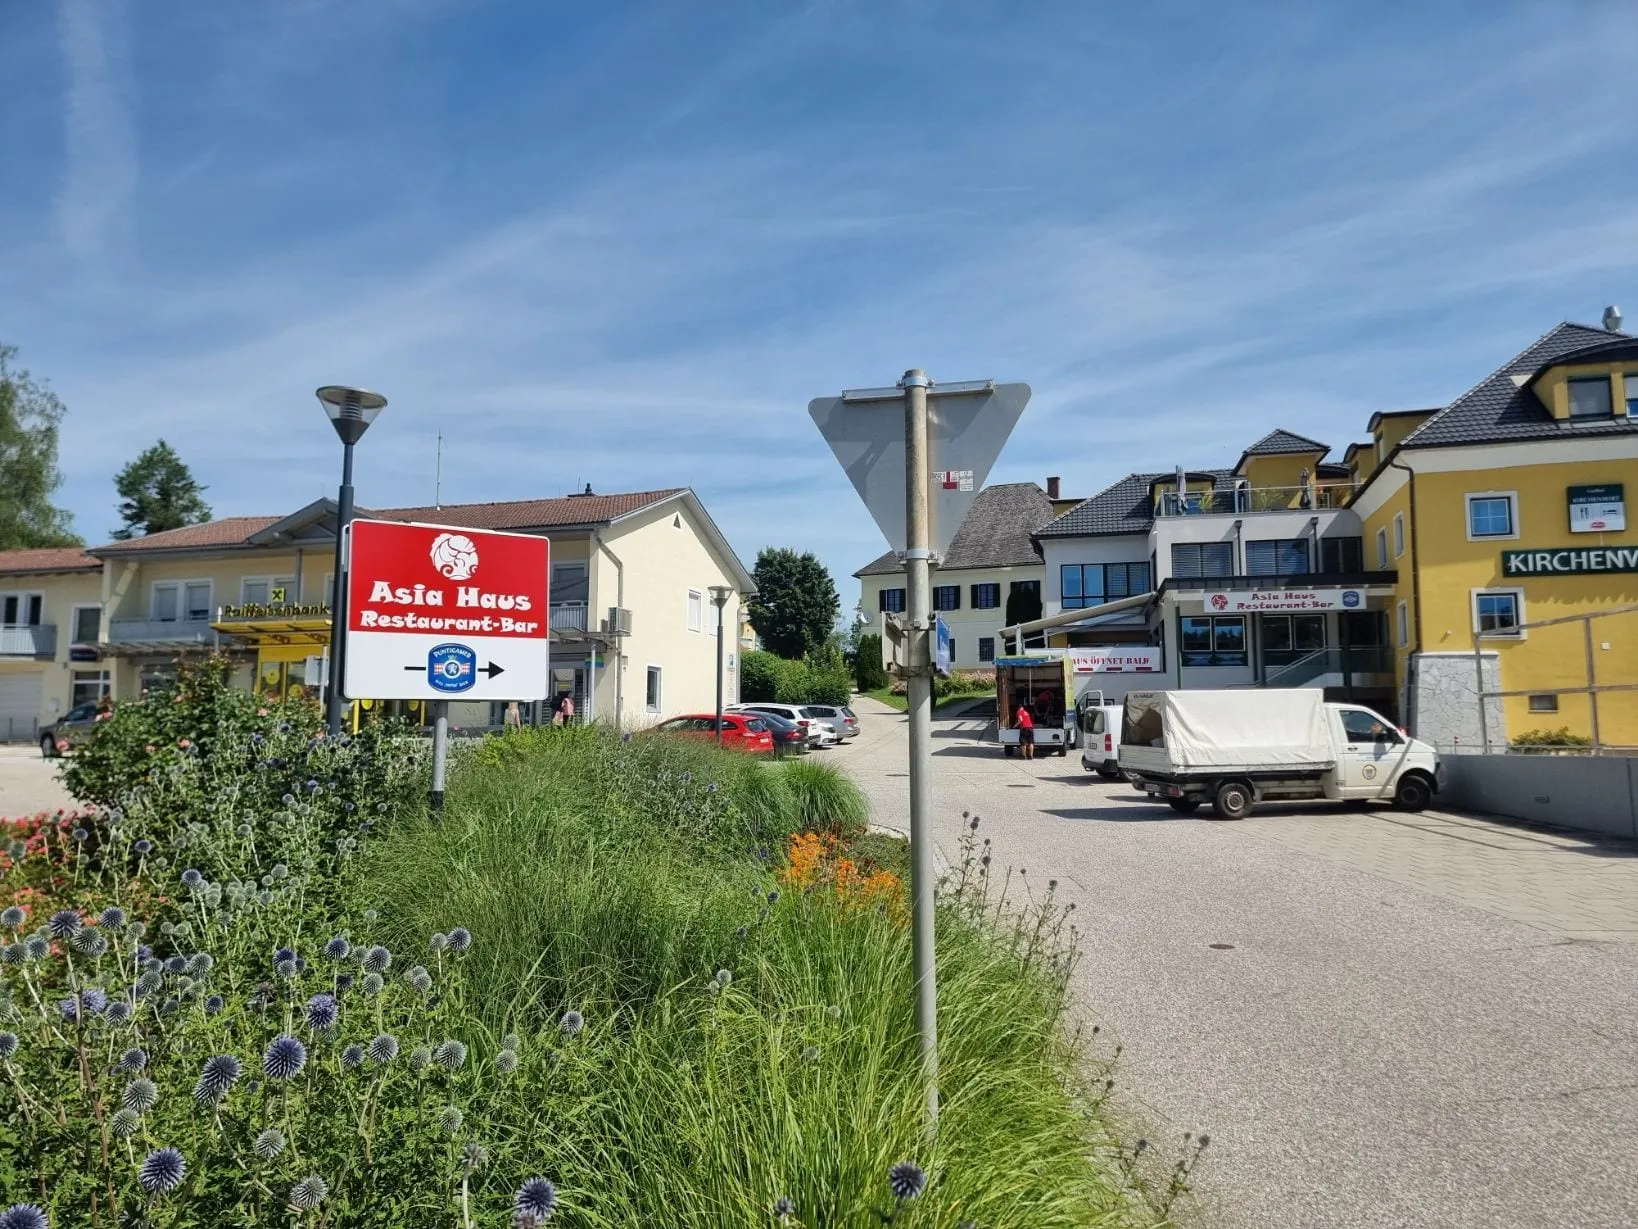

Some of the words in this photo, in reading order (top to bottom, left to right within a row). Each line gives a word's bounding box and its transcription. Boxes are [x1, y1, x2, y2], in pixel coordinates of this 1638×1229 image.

[368, 581, 444, 607] Asia
[456, 586, 532, 612] Haus
[1251, 593, 1279, 601] Asia
[1284, 592, 1317, 600] Haus
[224, 601, 331, 617] Raiffeisenbank
[1237, 601, 1335, 610] Restaurant-Bar
[360, 610, 538, 634] Restaurant-Bar
[1090, 656, 1124, 664] ÖFFNET
